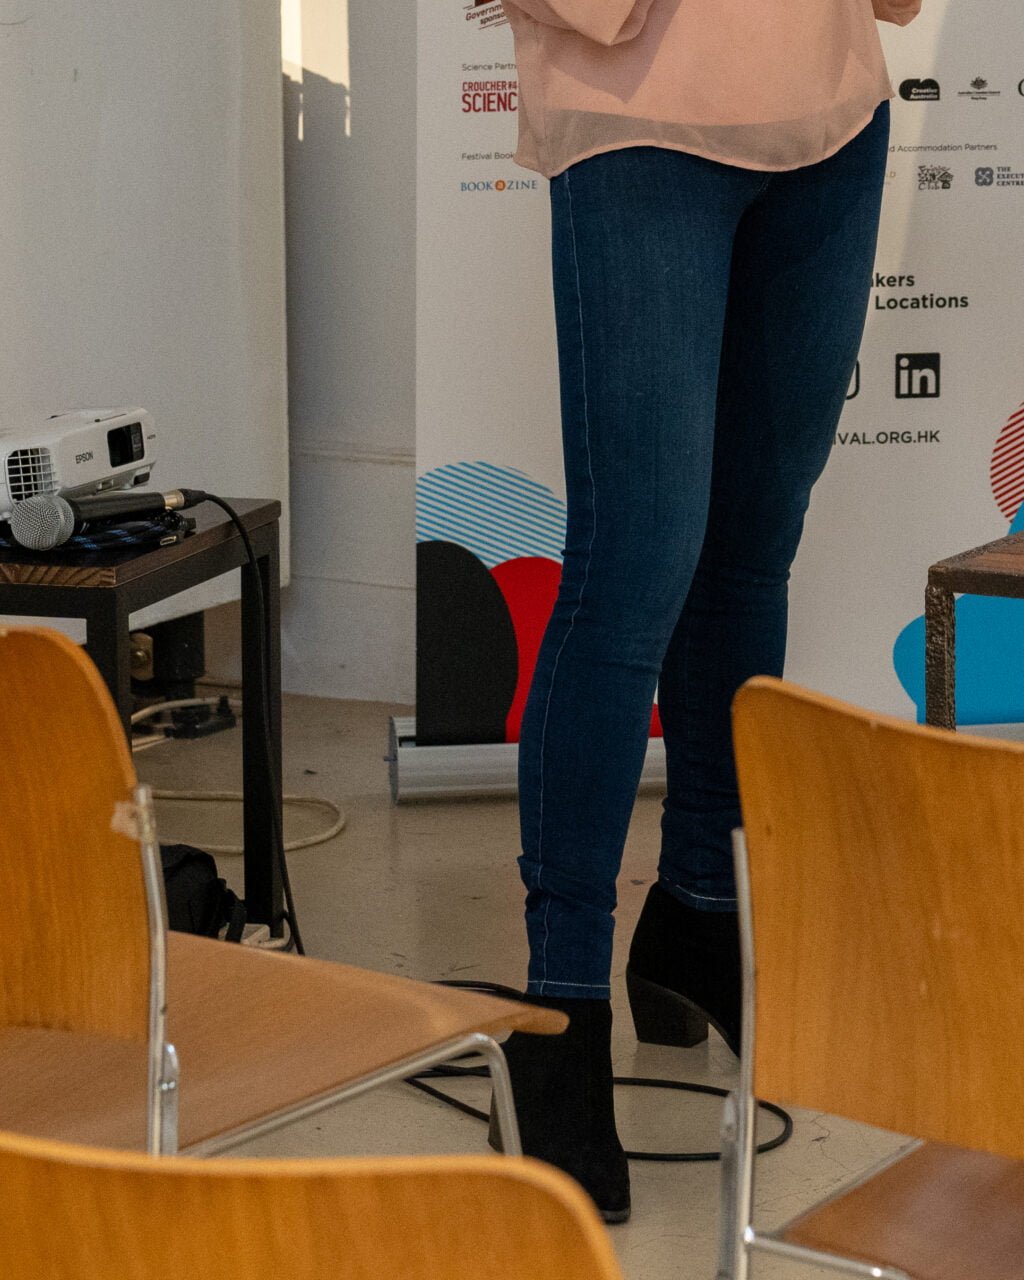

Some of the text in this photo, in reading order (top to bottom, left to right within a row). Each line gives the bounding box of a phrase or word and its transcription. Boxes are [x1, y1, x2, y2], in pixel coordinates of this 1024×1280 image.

[462, 63, 492, 71] Science
[462, 81, 506, 92] CROUCHER
[462, 92, 517, 113] SCIENC
[897, 144, 962, 152] Accommodation
[965, 143, 998, 151] Partners
[461, 152, 492, 160] Festival
[875, 294, 969, 309] Locations
[900, 357, 936, 394] in
[75, 451, 93, 464] EPSON
